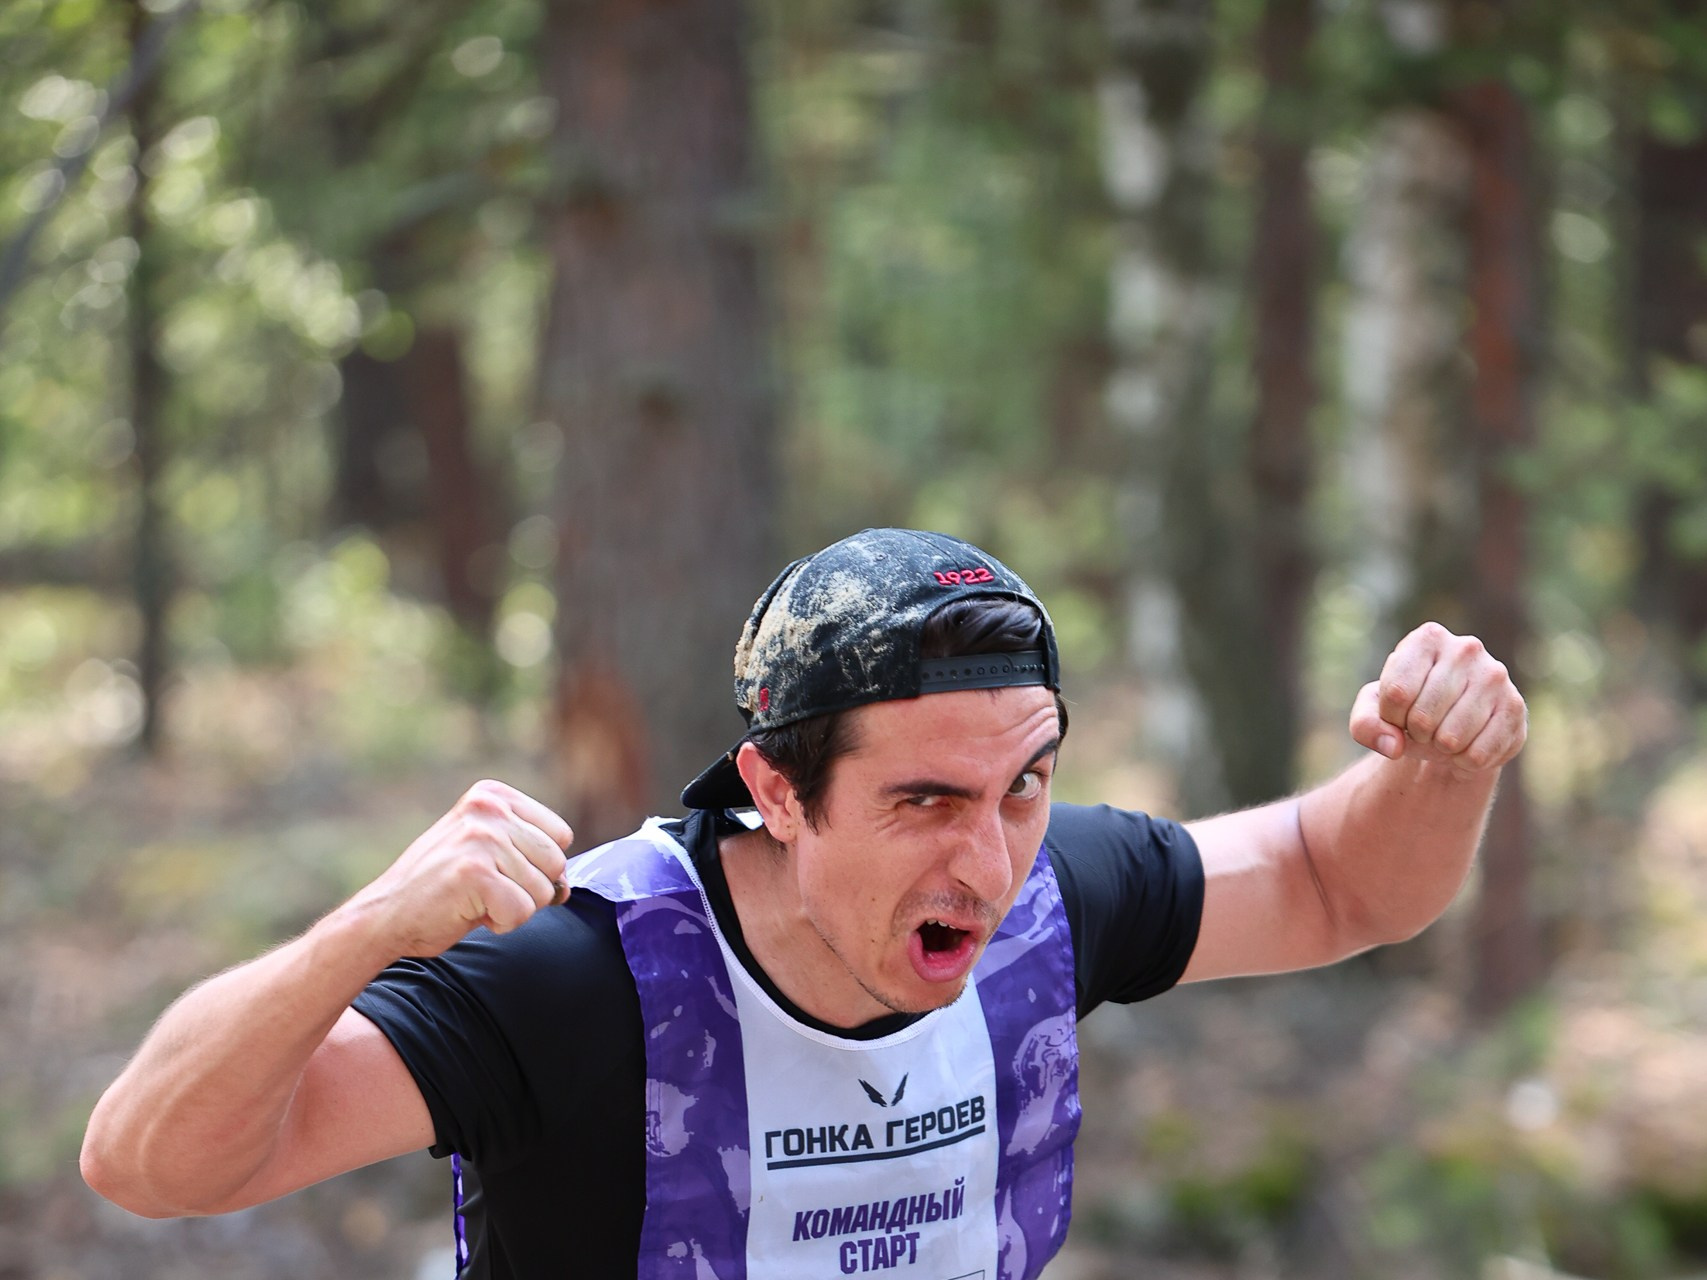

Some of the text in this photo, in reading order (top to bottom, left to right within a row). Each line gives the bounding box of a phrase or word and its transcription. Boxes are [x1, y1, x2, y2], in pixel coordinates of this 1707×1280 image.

[934, 568, 994, 585] 1922
[764, 1095, 986, 1158] ГОНКА ГЕРОЕВ
[792, 1176, 965, 1241] КОМАНДНЫЙ
[839, 1232, 920, 1274] СТАРТ
